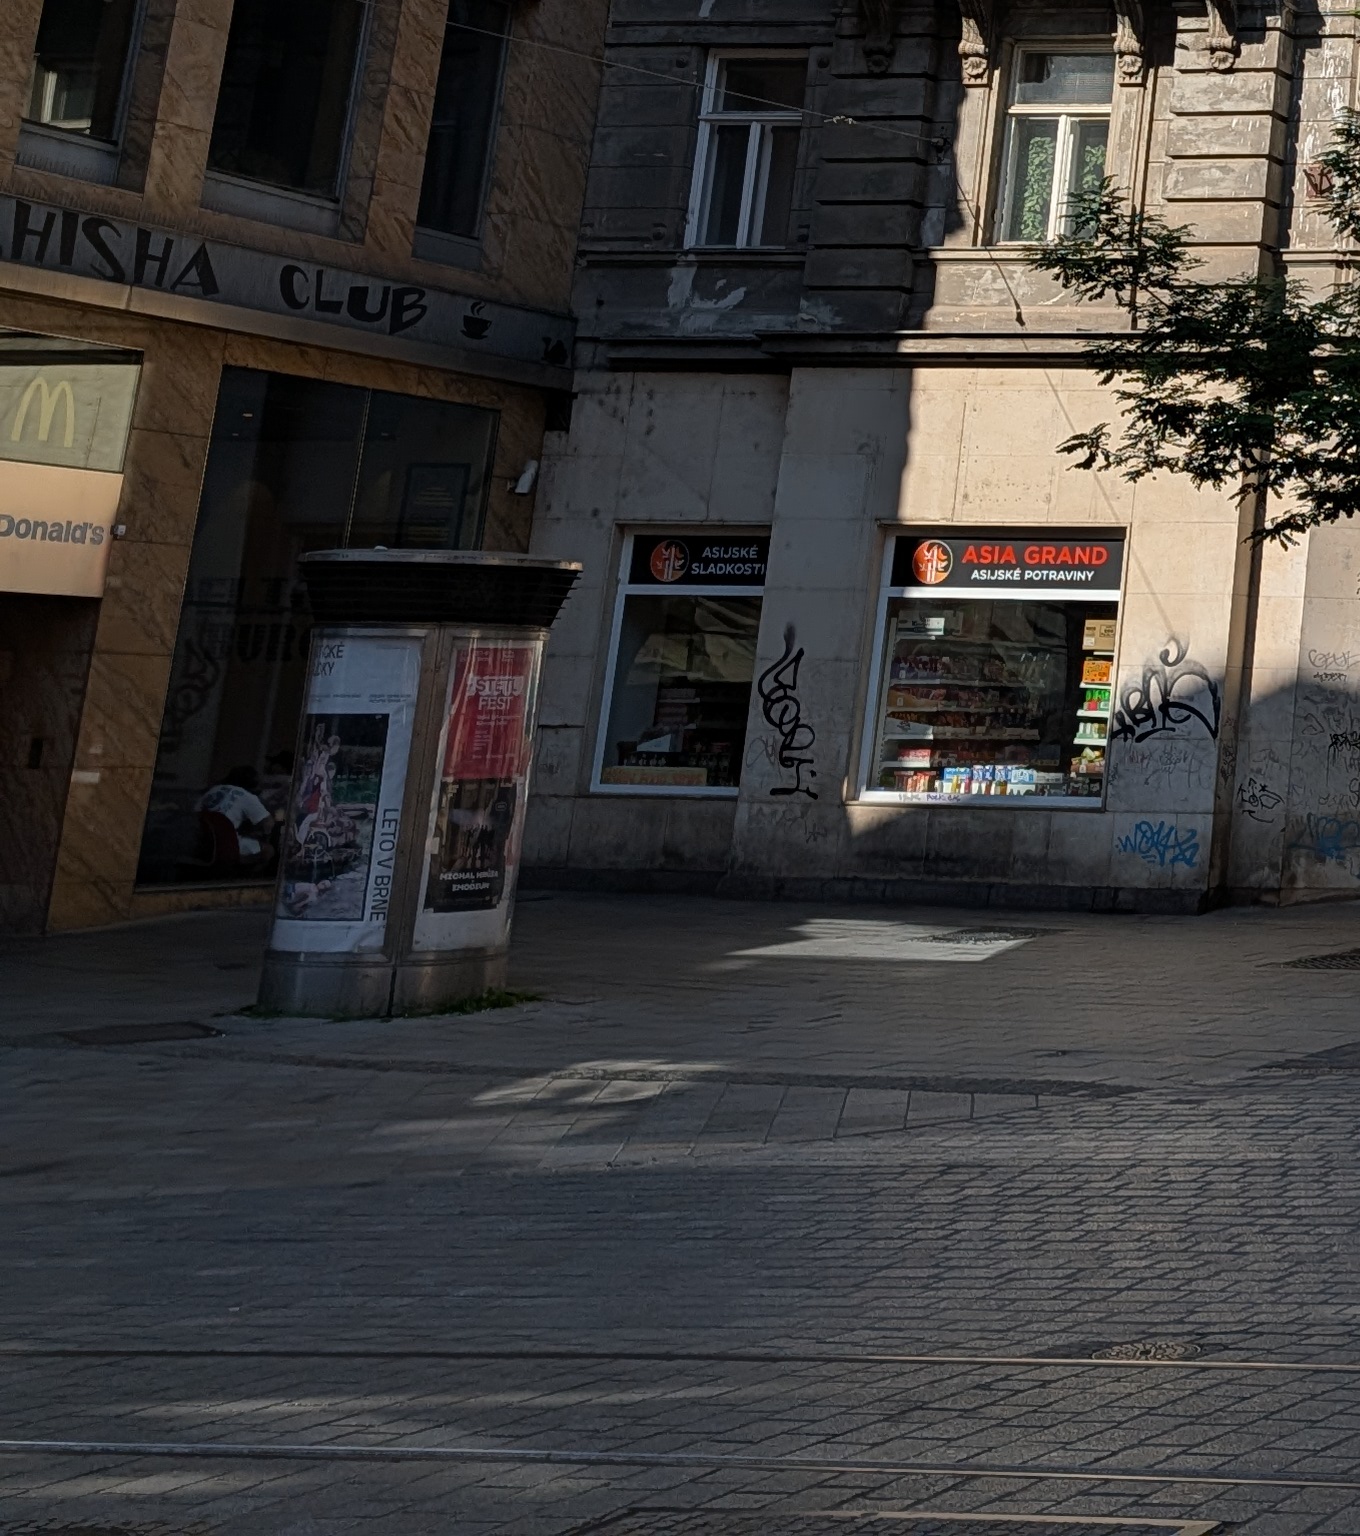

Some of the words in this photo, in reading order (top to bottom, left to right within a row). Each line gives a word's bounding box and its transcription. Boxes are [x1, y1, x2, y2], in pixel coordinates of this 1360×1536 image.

[0, 199, 220, 296] HISHA
[279, 264, 428, 336] CLUB
[0, 513, 105, 545] Donald's
[701, 544, 759, 559] ASIJSKÉ
[961, 545, 1017, 566] ASIA
[1023, 545, 1109, 566] GRAND
[690, 562, 766, 576] SLADKOSTI
[970, 567, 1022, 581] ASIJSKÉ
[1024, 570, 1095, 582] POTRAVINY
[478, 695, 513, 711] FEST
[376, 857, 394, 870] V
[439, 871, 475, 881] MICHAL
